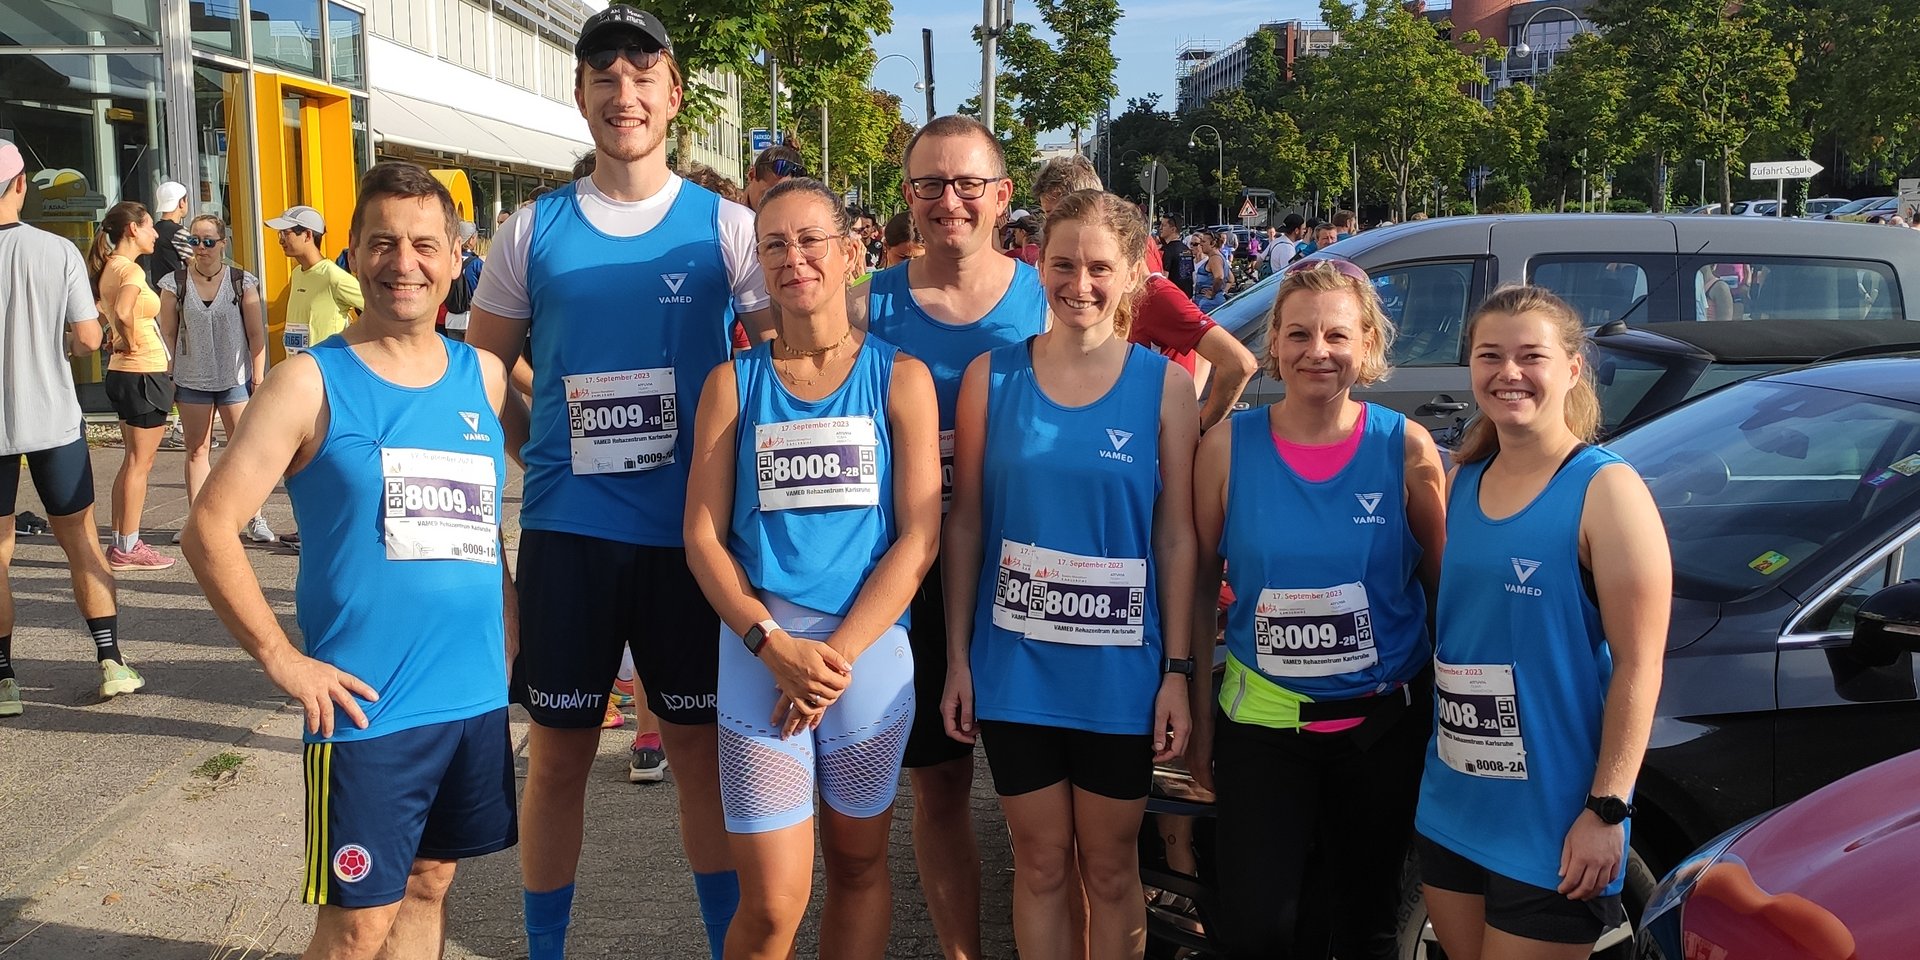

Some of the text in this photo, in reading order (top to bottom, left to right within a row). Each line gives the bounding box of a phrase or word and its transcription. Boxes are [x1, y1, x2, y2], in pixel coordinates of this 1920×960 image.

[1752, 164, 1812, 176] Zufahrt Schule
[658, 295, 692, 304] VAMED
[596, 374, 632, 383] September
[634, 372, 651, 380] 2023
[792, 421, 831, 432] September
[832, 420, 850, 428] 2023
[463, 432, 491, 442] VAMED
[612, 436, 648, 444] Rehazentrum
[1099, 449, 1134, 463] VAMED
[785, 486, 871, 497] VAMED Rehazentrum Karlsruhe
[1352, 515, 1386, 525] VAMED
[462, 542, 497, 558] 8009-1A
[1057, 558, 1068, 566] 17.
[1069, 559, 1107, 569] September
[1272, 589, 1343, 601] 17. September 2023
[1504, 583, 1542, 597] VAMED
[1053, 624, 1074, 633] VAMED
[1074, 626, 1111, 635] Rehazentrum
[1303, 657, 1342, 665] Rehazentrum
[1342, 653, 1370, 662] Karlsruhe
[1465, 668, 1483, 676] 2023
[538, 688, 602, 710] DURAVIT
[1476, 759, 1526, 773] 8008-2A
